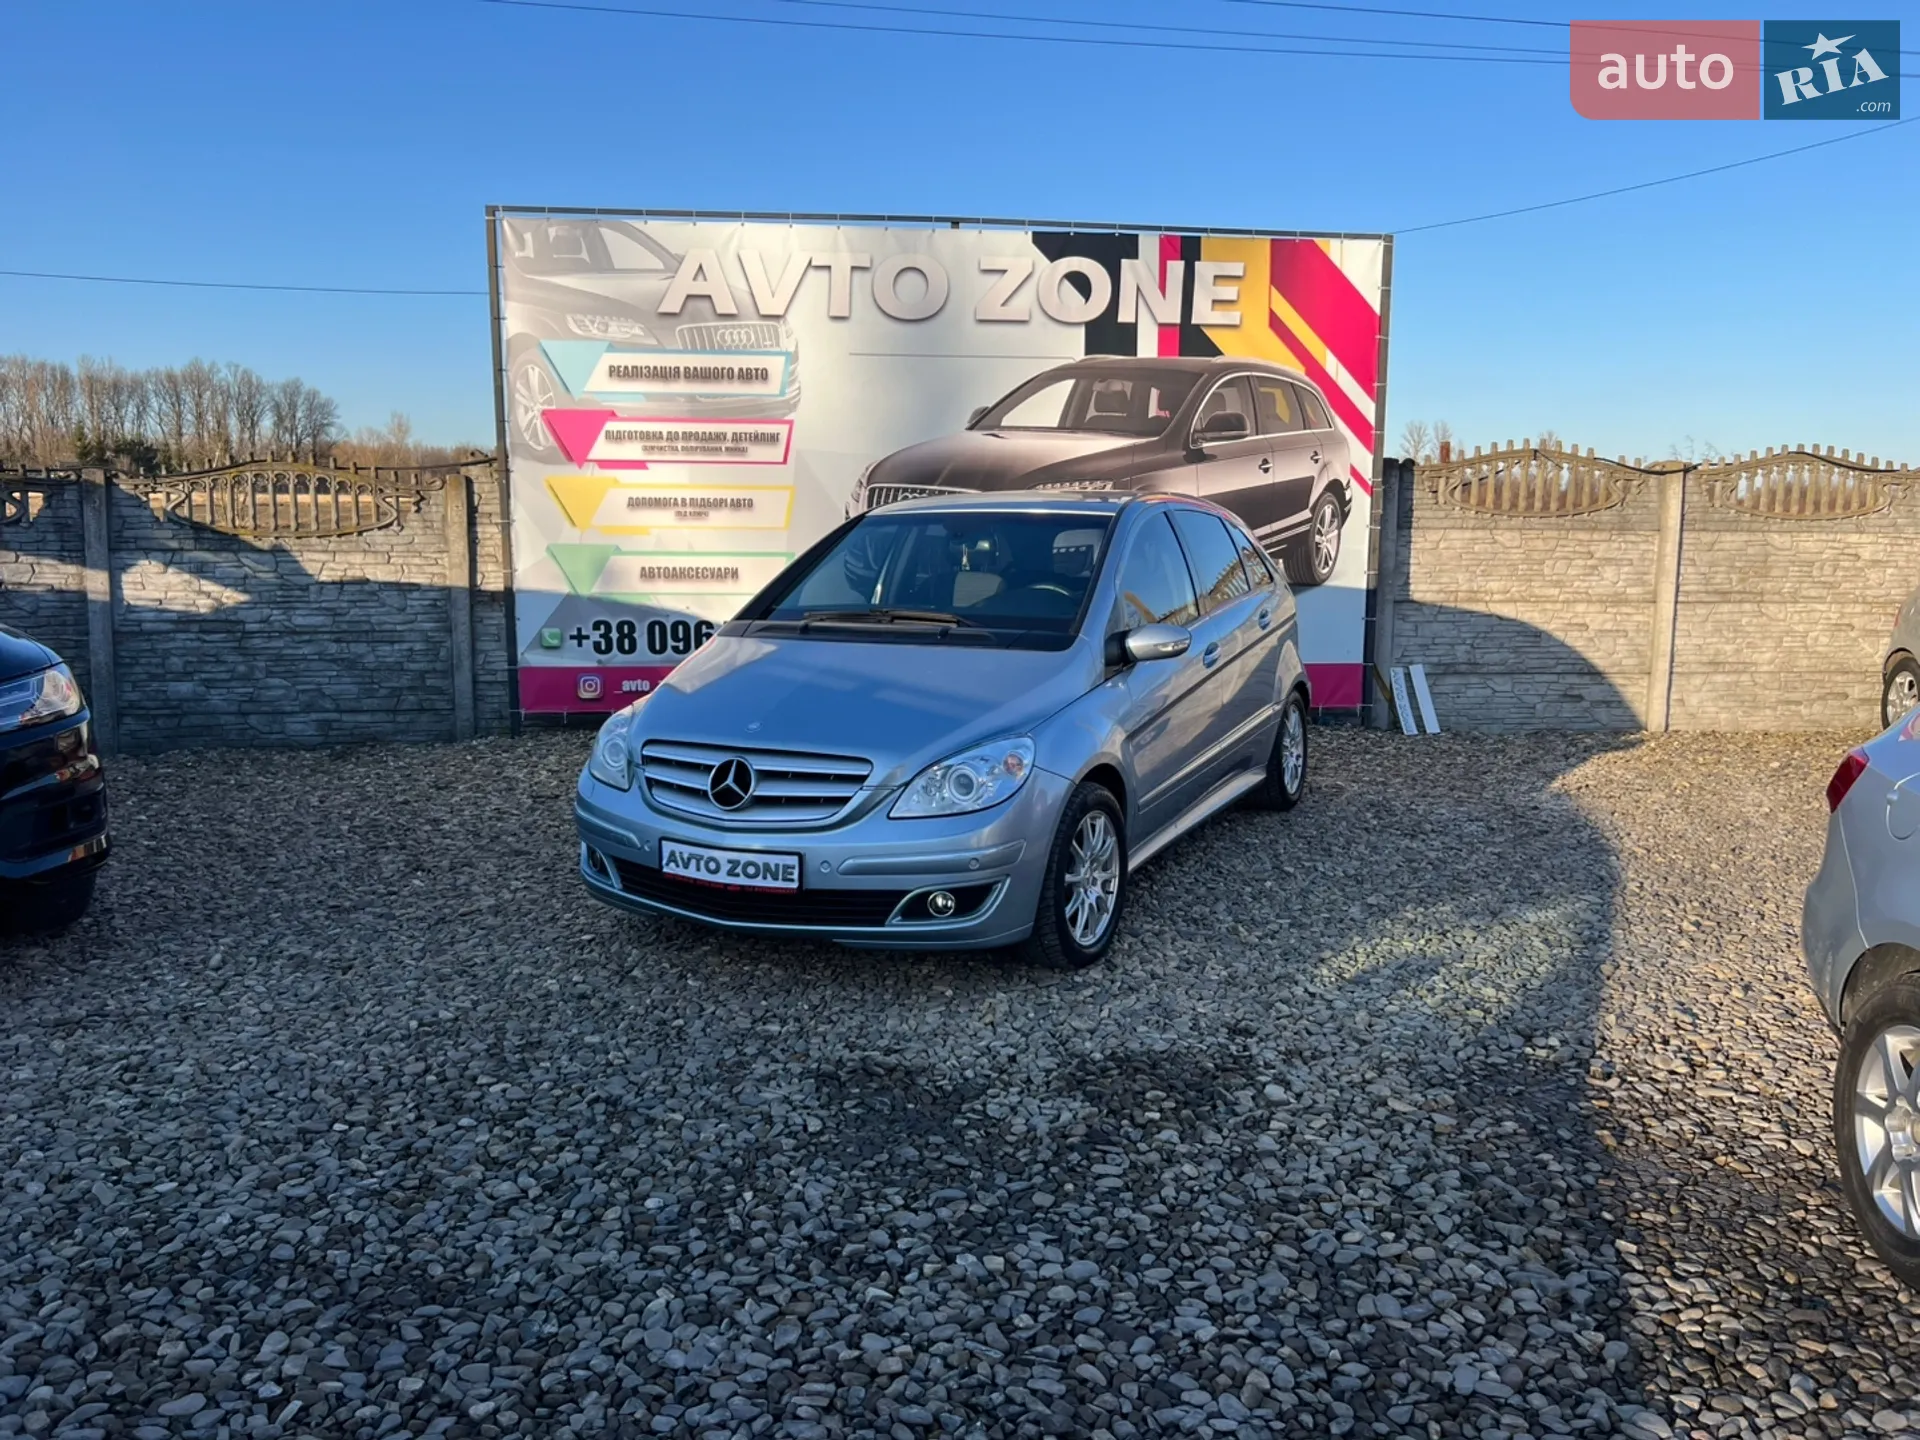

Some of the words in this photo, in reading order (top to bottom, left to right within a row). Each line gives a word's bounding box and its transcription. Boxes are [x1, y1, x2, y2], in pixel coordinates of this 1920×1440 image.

[657, 248, 949, 321] AVTO
[975, 255, 1245, 326] ZONE
[608, 365, 681, 381] РЕАЛІЗАЦІЯ
[683, 366, 735, 381] ВАШОГО
[737, 367, 769, 381] АВТО
[604, 430, 664, 442] ПІДГОТОВКА
[665, 431, 680, 443] ДО
[731, 430, 781, 443] ДЕТЕЙЛІНГ
[627, 496, 679, 508] ДОПОМОГА
[680, 497, 687, 508] В
[689, 497, 728, 509] ПІДБОРІ
[729, 498, 754, 508] АВТО
[639, 566, 740, 580] АВТОАКСЕСУАРИ
[569, 619, 638, 656] +38
[646, 619, 716, 656] 096
[613, 679, 651, 694] _avto
[665, 849, 722, 875] AVTO
[726, 859, 797, 883] ZONE
